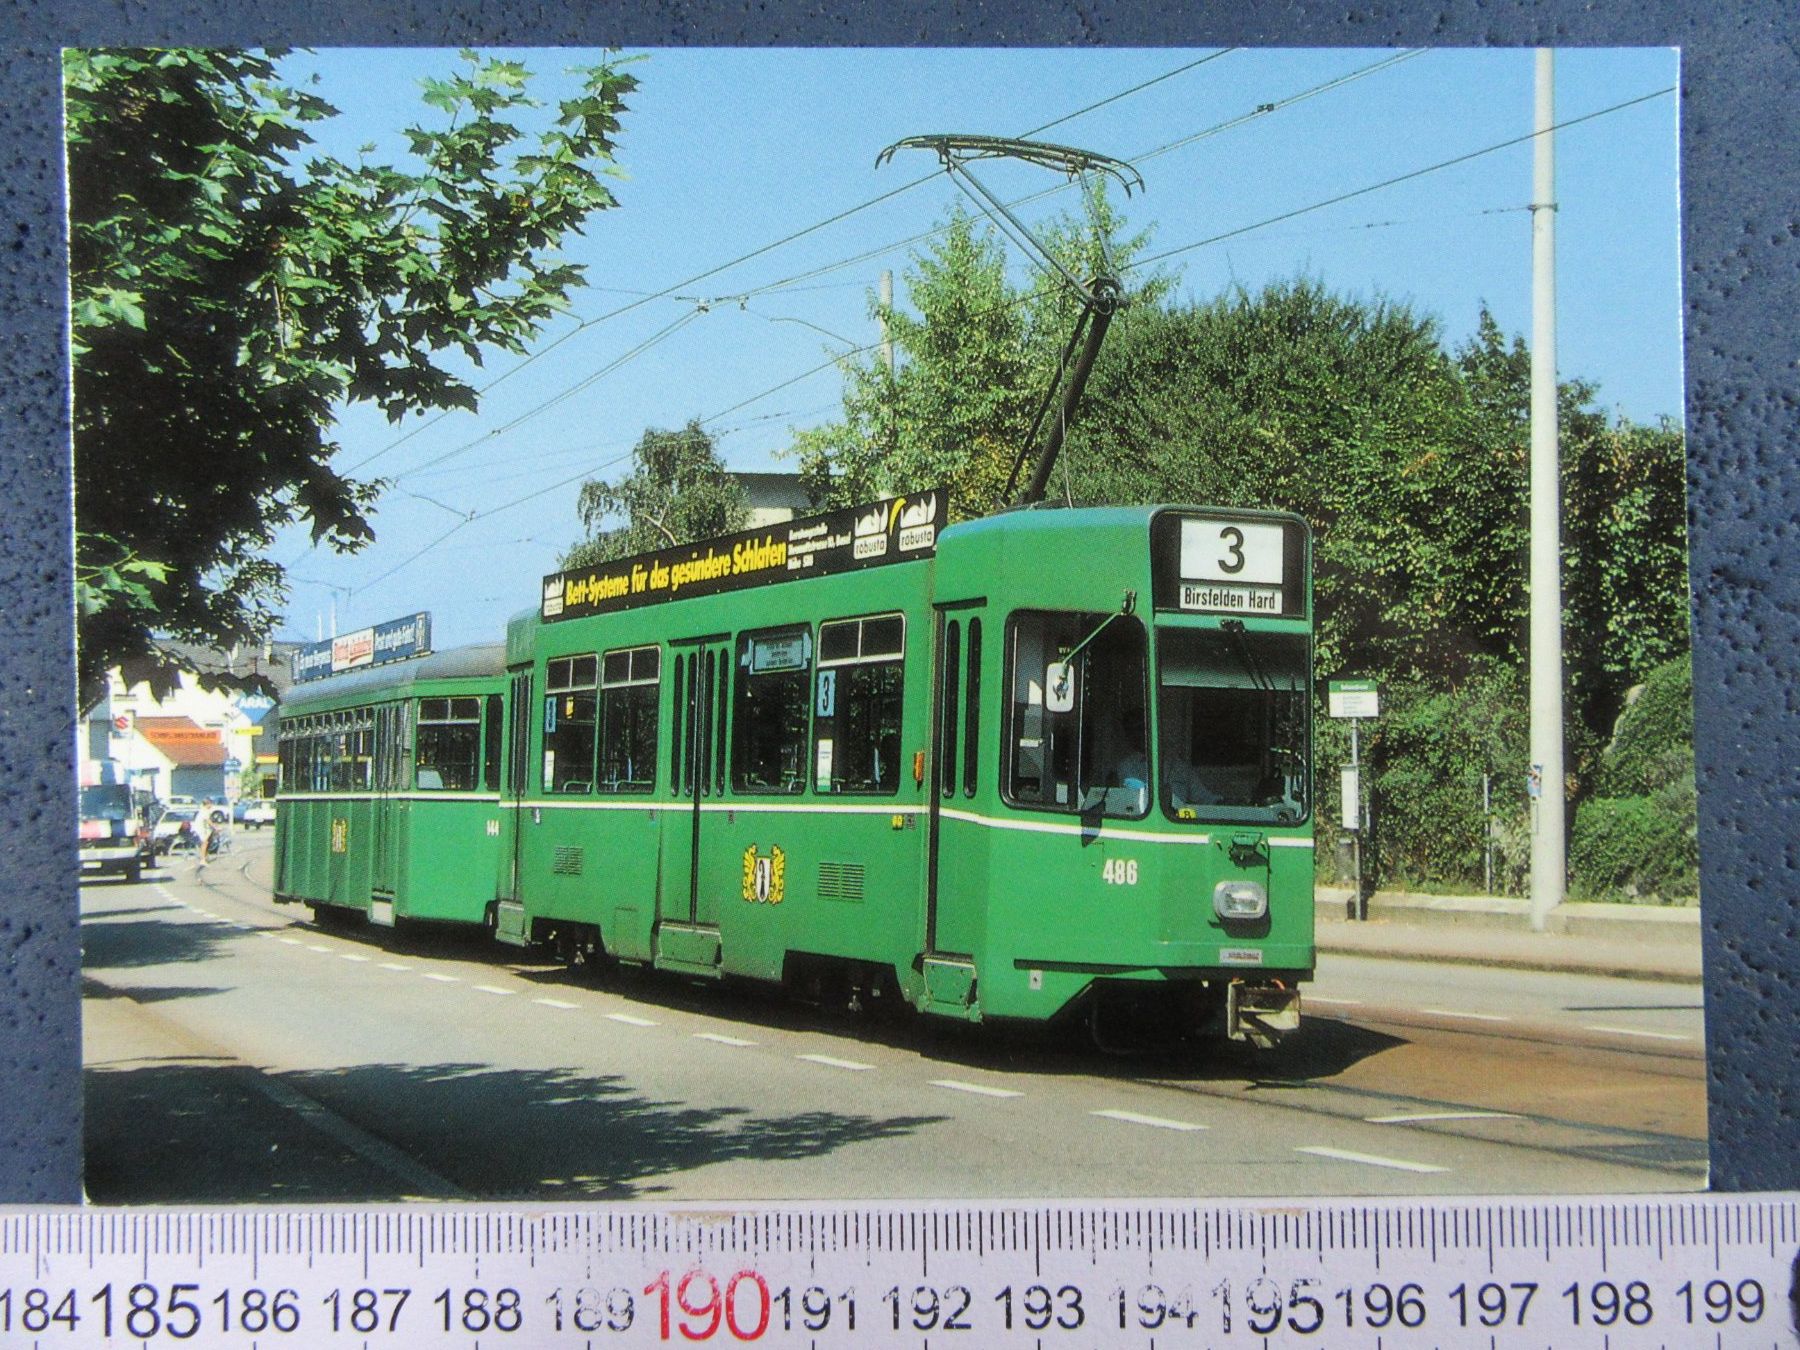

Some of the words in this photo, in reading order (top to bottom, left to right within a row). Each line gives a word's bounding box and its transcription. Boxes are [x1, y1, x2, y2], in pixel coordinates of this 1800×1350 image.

[855, 539, 886, 555] robusta
[899, 530, 933, 545] robusta
[1217, 526, 1245, 574] 3
[565, 574, 630, 607] Bett-Systeme
[631, 563, 649, 594] für
[650, 559, 670, 591] das
[671, 547, 731, 592] gesündere
[732, 535, 787, 575] Schlafen
[1184, 587, 1244, 609] Birsfelden
[1249, 590, 1276, 610] Hard
[823, 676, 830, 711] 3
[1102, 859, 1139, 886] 486
[0, 1287, 82, 1333] 184
[92, 1281, 202, 1339] 185
[213, 1287, 301, 1334] 186
[322, 1287, 413, 1333] 187
[433, 1287, 524, 1334] 188
[546, 1286, 637, 1333] 189
[643, 1268, 771, 1341] 190
[774, 1285, 857, 1331] 191
[882, 1285, 973, 1331] 192
[994, 1284, 1086, 1331] 193
[1109, 1282, 1200, 1330] 194
[1211, 1276, 1327, 1335] 195
[1335, 1281, 1428, 1329] 196
[1447, 1281, 1540, 1328] 197
[1561, 1280, 1655, 1327] 198
[1674, 1279, 1766, 1326] 199
